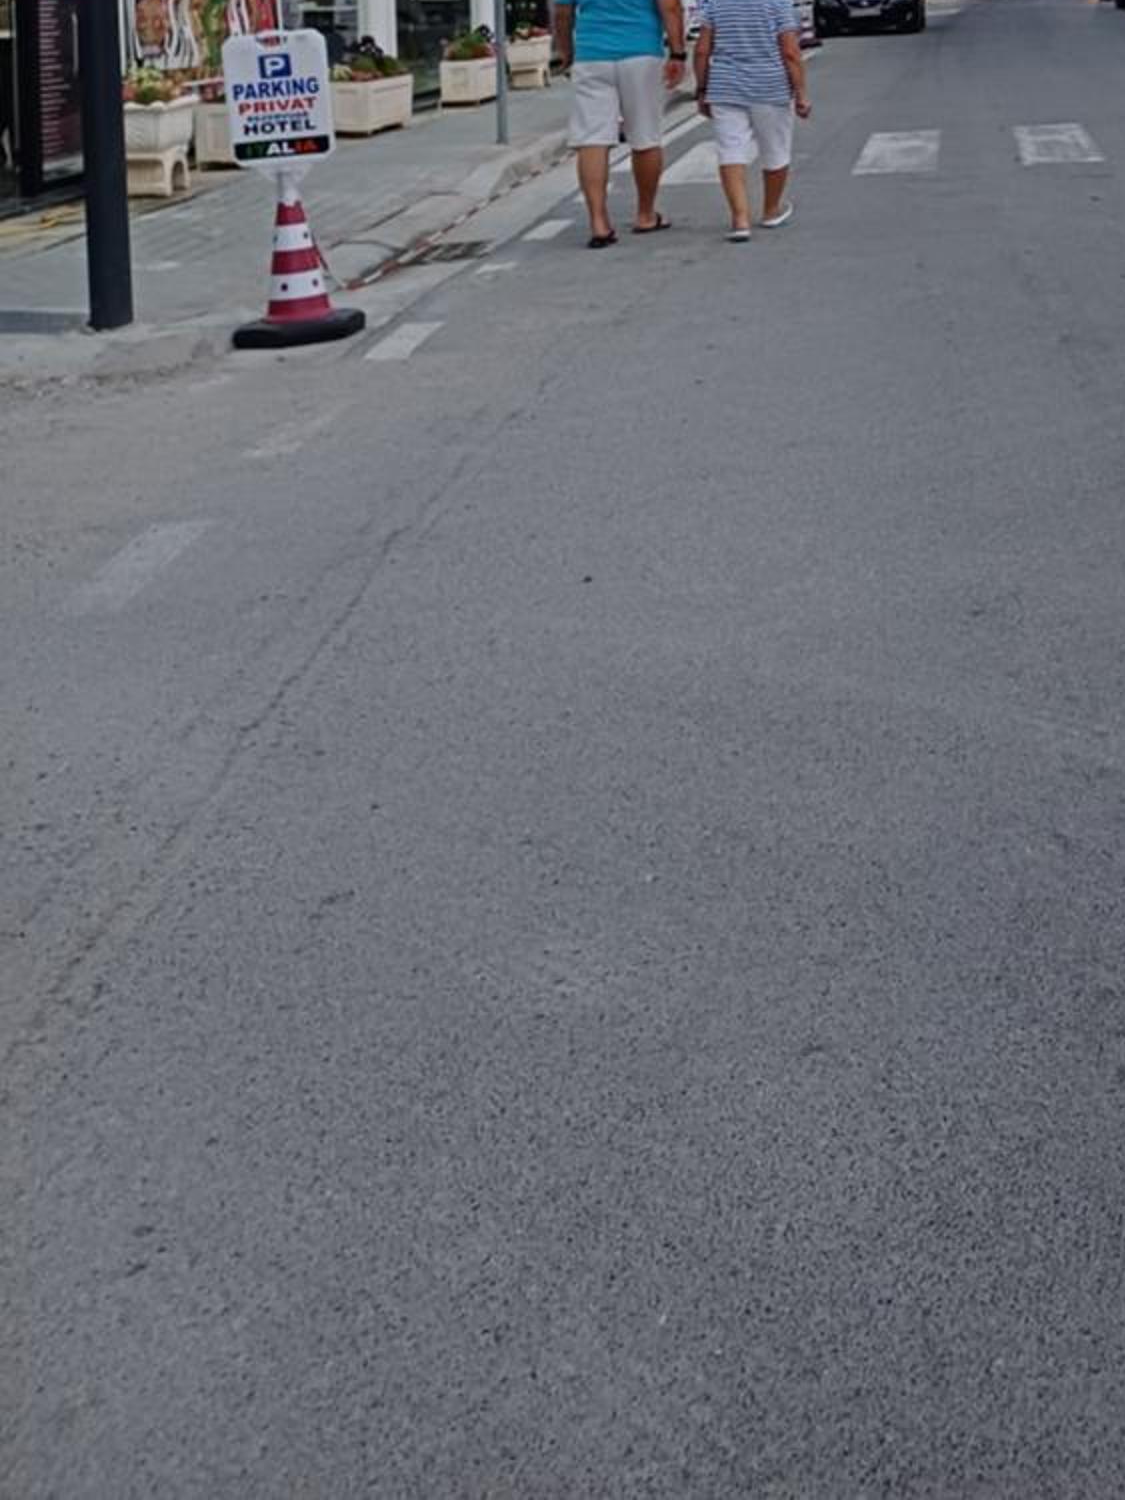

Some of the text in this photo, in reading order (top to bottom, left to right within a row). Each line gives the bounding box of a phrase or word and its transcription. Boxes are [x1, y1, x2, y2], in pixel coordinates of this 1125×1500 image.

[263, 56, 286, 77] P
[233, 77, 320, 100] PARKING
[239, 97, 317, 114] PRIVAT
[244, 120, 316, 135] HOTEL
